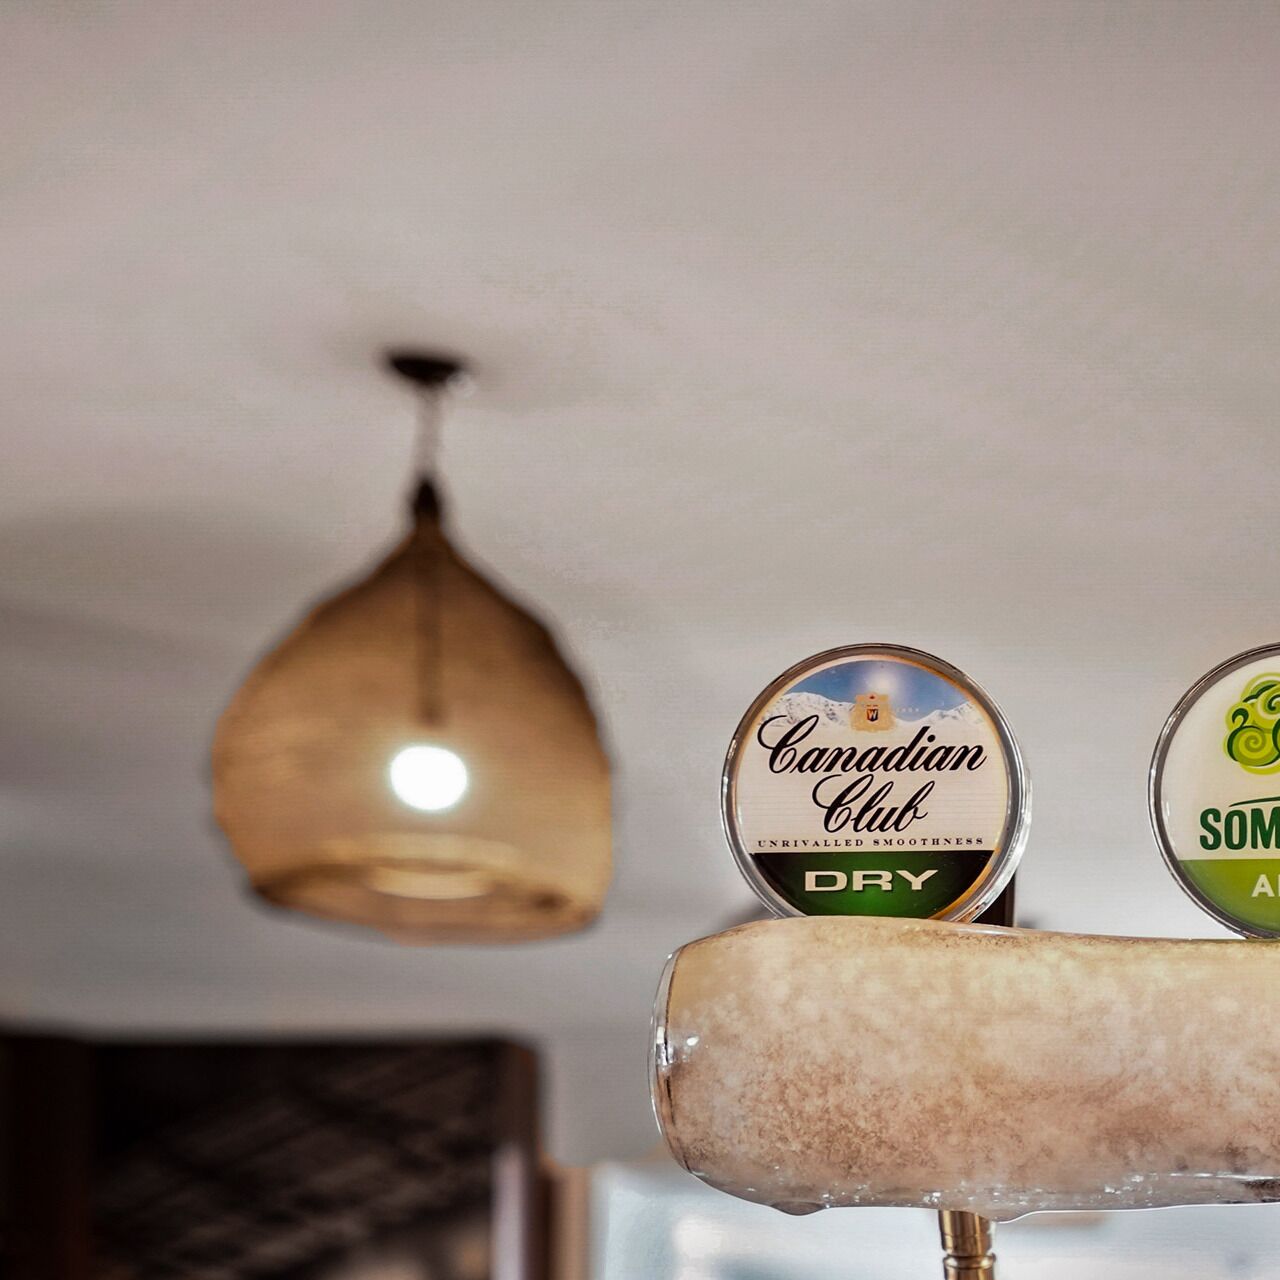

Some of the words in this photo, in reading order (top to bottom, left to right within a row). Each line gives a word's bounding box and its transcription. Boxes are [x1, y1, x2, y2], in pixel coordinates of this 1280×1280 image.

[757, 714, 988, 774] Canadian
[812, 774, 936, 833] Club
[758, 838, 864, 848] UNRIVALLED
[873, 836, 984, 847] SMOOTHNESS
[804, 869, 940, 892] DRY
